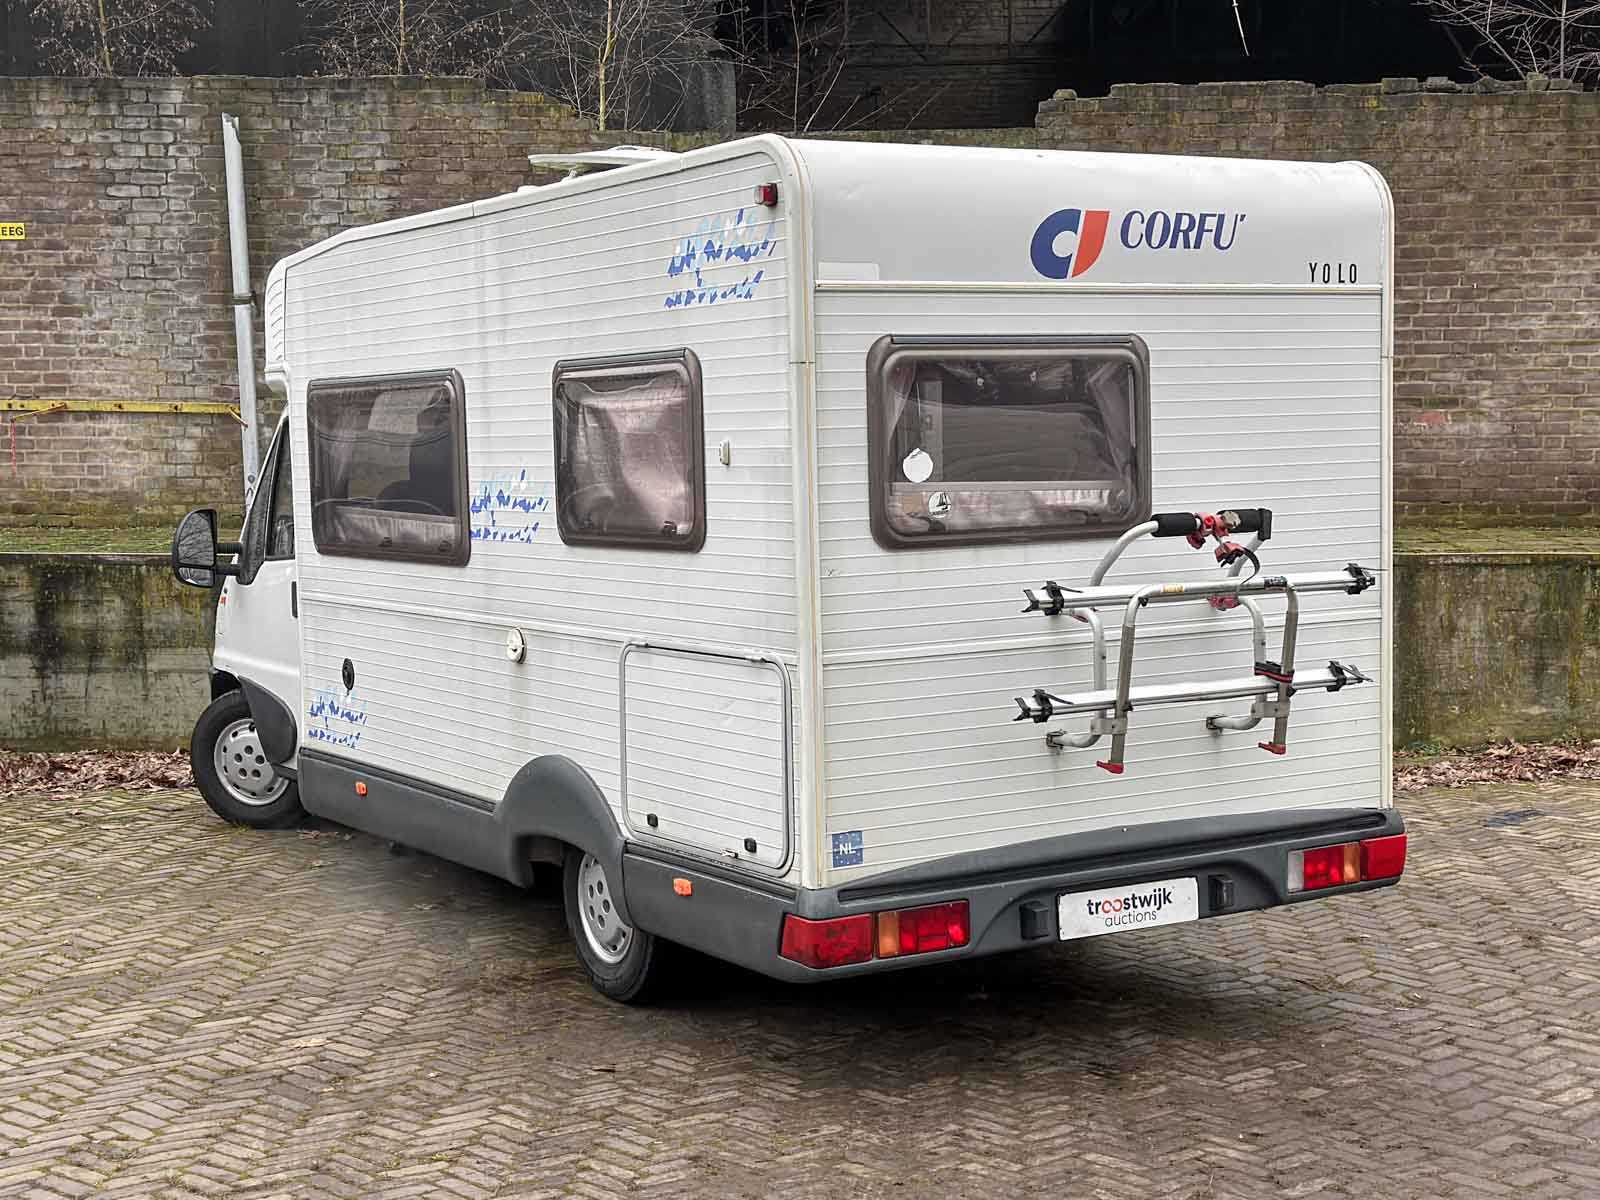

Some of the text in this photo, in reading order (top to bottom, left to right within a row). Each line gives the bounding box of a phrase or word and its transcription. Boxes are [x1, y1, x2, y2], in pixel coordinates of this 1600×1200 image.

[1308, 262, 1357, 284] YOLO
[839, 842, 857, 856] NL
[1087, 887, 1173, 915] troostwijk
[1104, 910, 1157, 928] auctions
